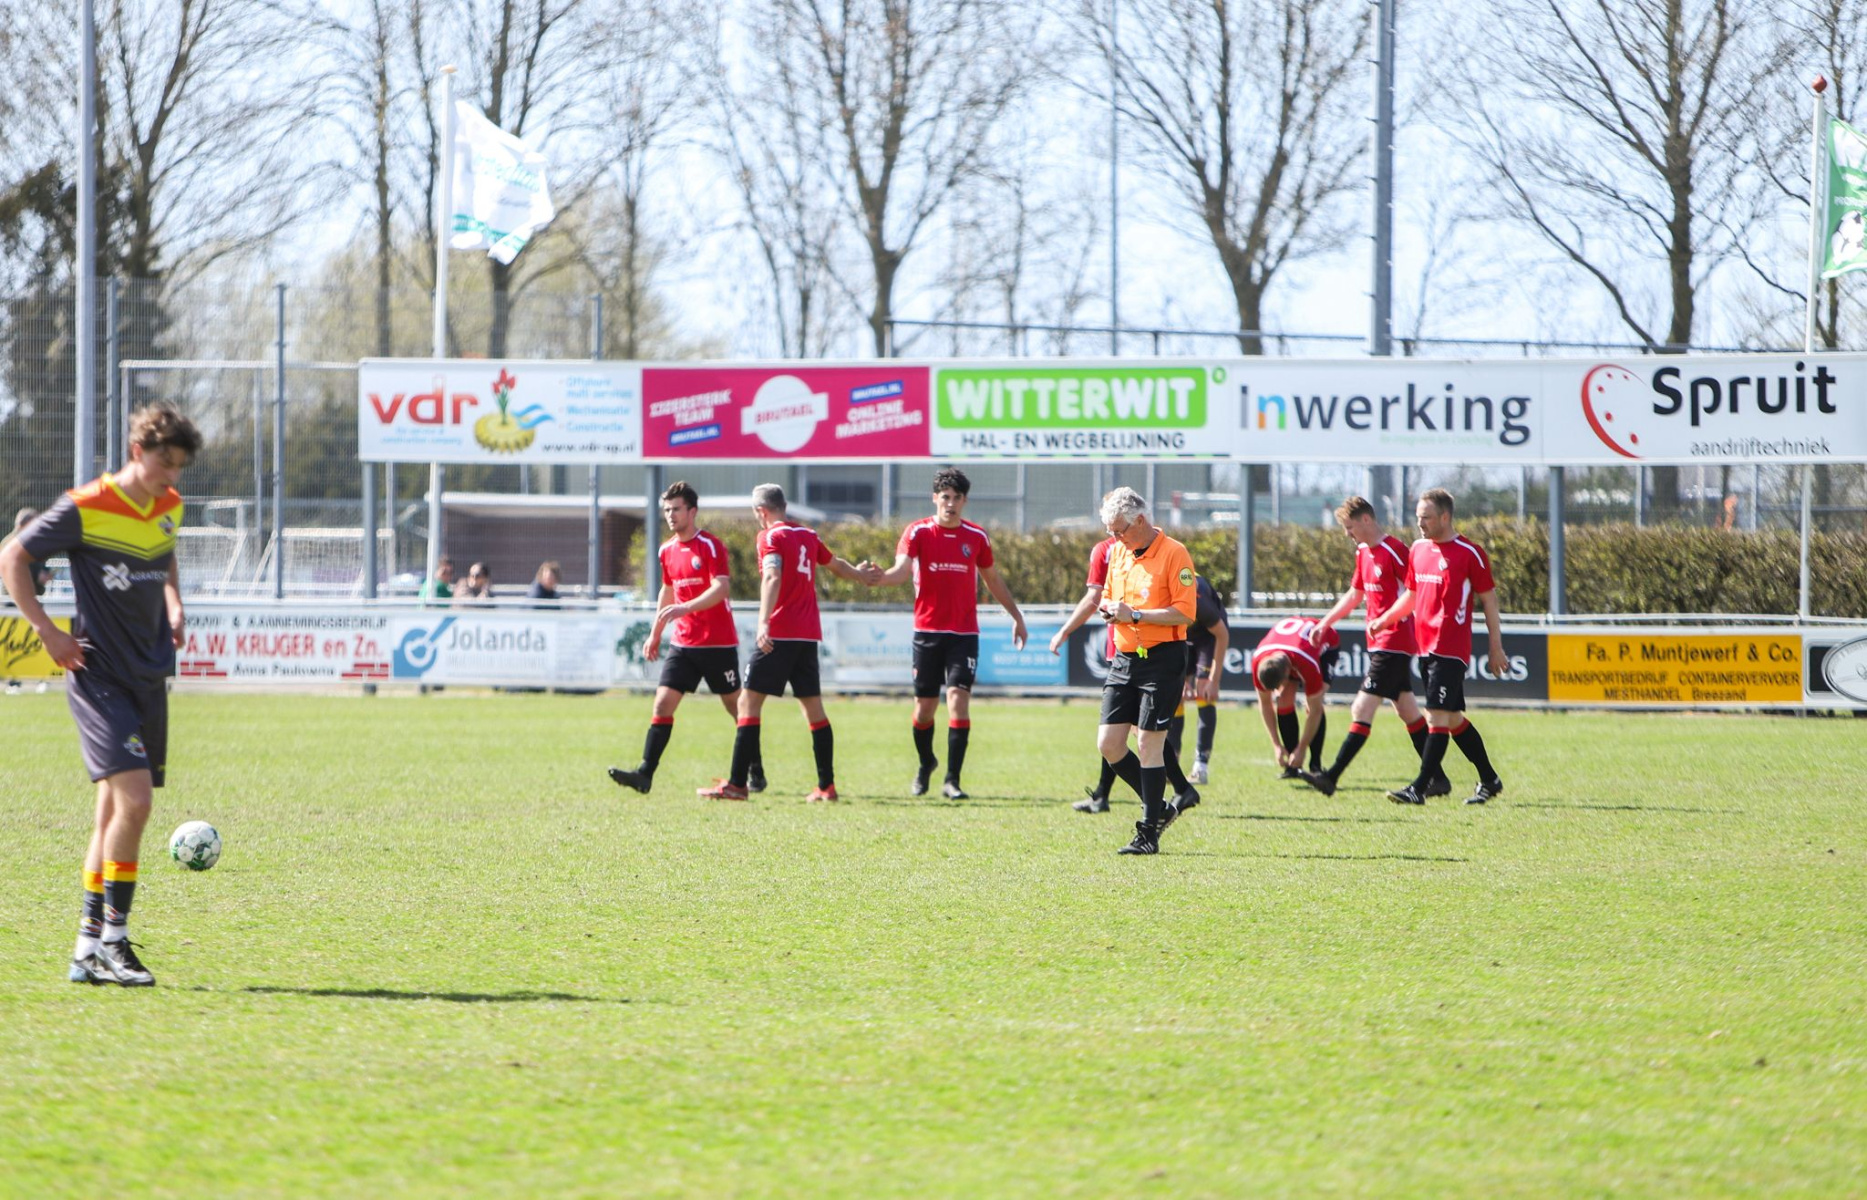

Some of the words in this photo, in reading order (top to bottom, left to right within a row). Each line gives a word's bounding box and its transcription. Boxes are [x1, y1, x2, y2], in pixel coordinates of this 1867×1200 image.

[368, 374, 479, 425] vdr
[945, 377, 1197, 421] WITTERWIT
[1651, 361, 1837, 427] Spruit
[962, 432, 1006, 449] HAL-
[1014, 432, 1038, 449] EN
[1690, 437, 1831, 458] aandrijftechniek
[797, 545, 812, 582] 4
[186, 633, 230, 657] A.W.
[323, 639, 347, 657] en
[353, 634, 384, 658] Zn.
[448, 624, 548, 651] Jolanda
[966, 656, 977, 670] 13
[1586, 642, 1612, 662] Fa.
[1618, 642, 1634, 662] P.
[1641, 642, 1739, 665] Muntjewerf
[1746, 642, 1760, 662] &
[1768, 642, 1798, 663] Co.
[724, 669, 736, 683] 12
[1551, 670, 1669, 686] TRANSPORTBEDRIJF
[1678, 670, 1800, 687] CONTAINERVERVOER
[1439, 686, 1448, 699] 5
[1603, 686, 1683, 702] MESTHANDEL
